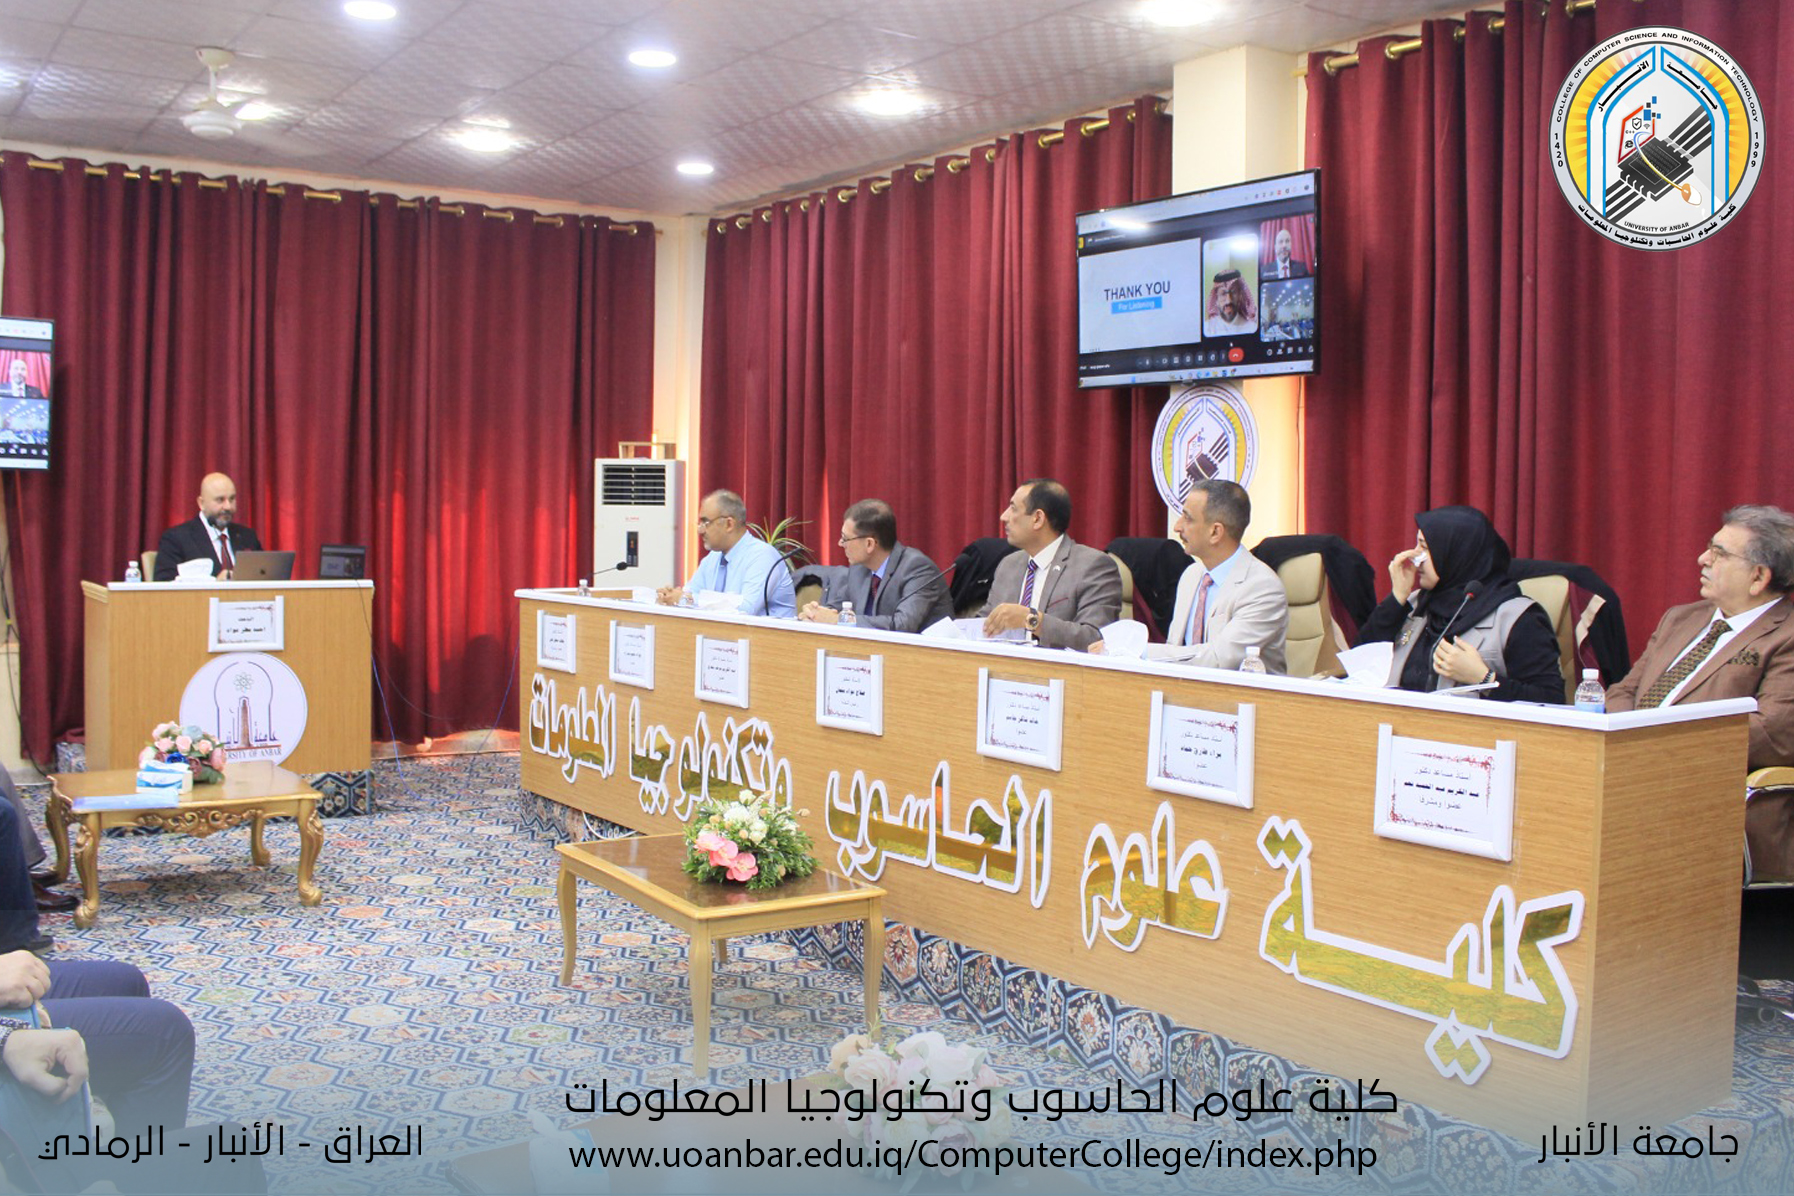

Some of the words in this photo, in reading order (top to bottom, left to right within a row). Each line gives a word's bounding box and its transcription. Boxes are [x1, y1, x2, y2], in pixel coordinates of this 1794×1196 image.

[1104, 284, 1143, 301] THANK
[1145, 280, 1171, 295] YOU
[529, 673, 617, 783] المعلومات
[825, 760, 1052, 909] الحاسوب
[1080, 801, 1229, 953] علوم
[1257, 816, 1585, 1086] كلية
